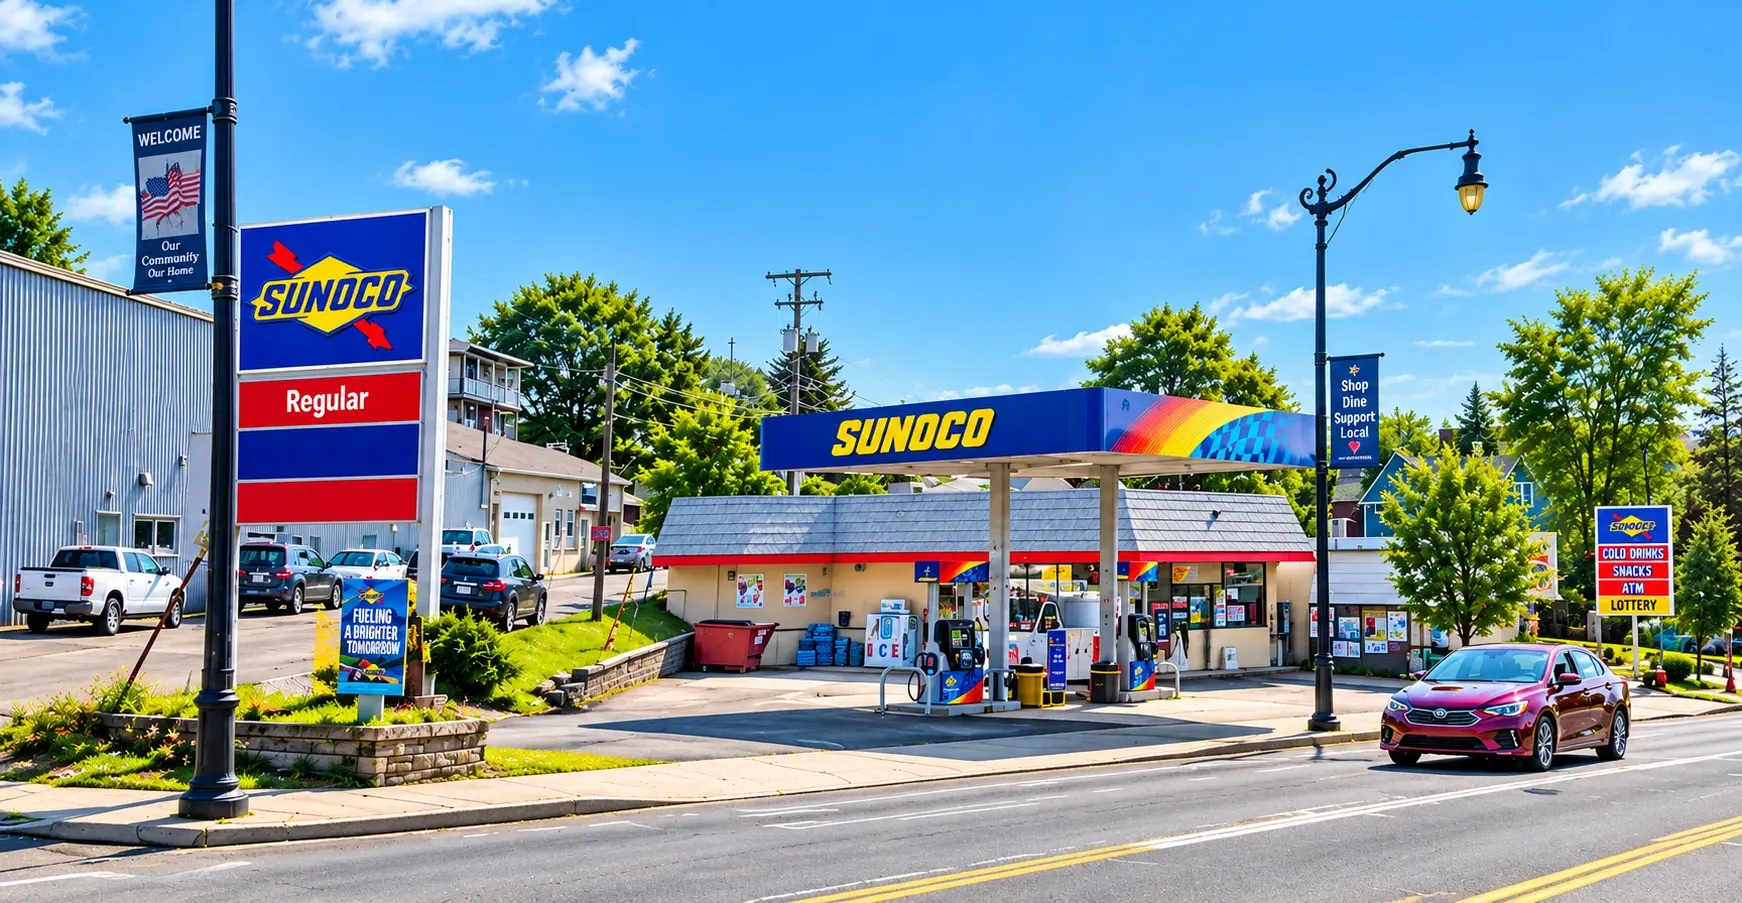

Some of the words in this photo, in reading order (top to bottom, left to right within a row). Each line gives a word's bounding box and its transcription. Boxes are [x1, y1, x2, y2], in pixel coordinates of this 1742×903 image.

[137, 125, 201, 147] WELCOME
[161, 240, 181, 252] Our
[147, 268, 165, 278] Our
[167, 266, 194, 277] Home
[258, 273, 405, 317] SUNOCO
[1341, 379, 1369, 394] Shop
[286, 384, 369, 419] Regular
[1342, 395, 1367, 409] Dine
[1334, 410, 1376, 426] Support
[831, 408, 995, 457] SUNOCO
[1340, 425, 1369, 439] Local
[1602, 548, 1626, 560] COLD
[1630, 547, 1664, 560] DRINKS
[1613, 565, 1652, 577] SNACKS
[1622, 582, 1645, 594] ATM
[1611, 599, 1657, 611] LOTTERY
[353, 608, 393, 625] FUELING
[344, 624, 352, 639] A
[353, 625, 398, 641] BRIGHTER
[867, 643, 899, 658] ICE
